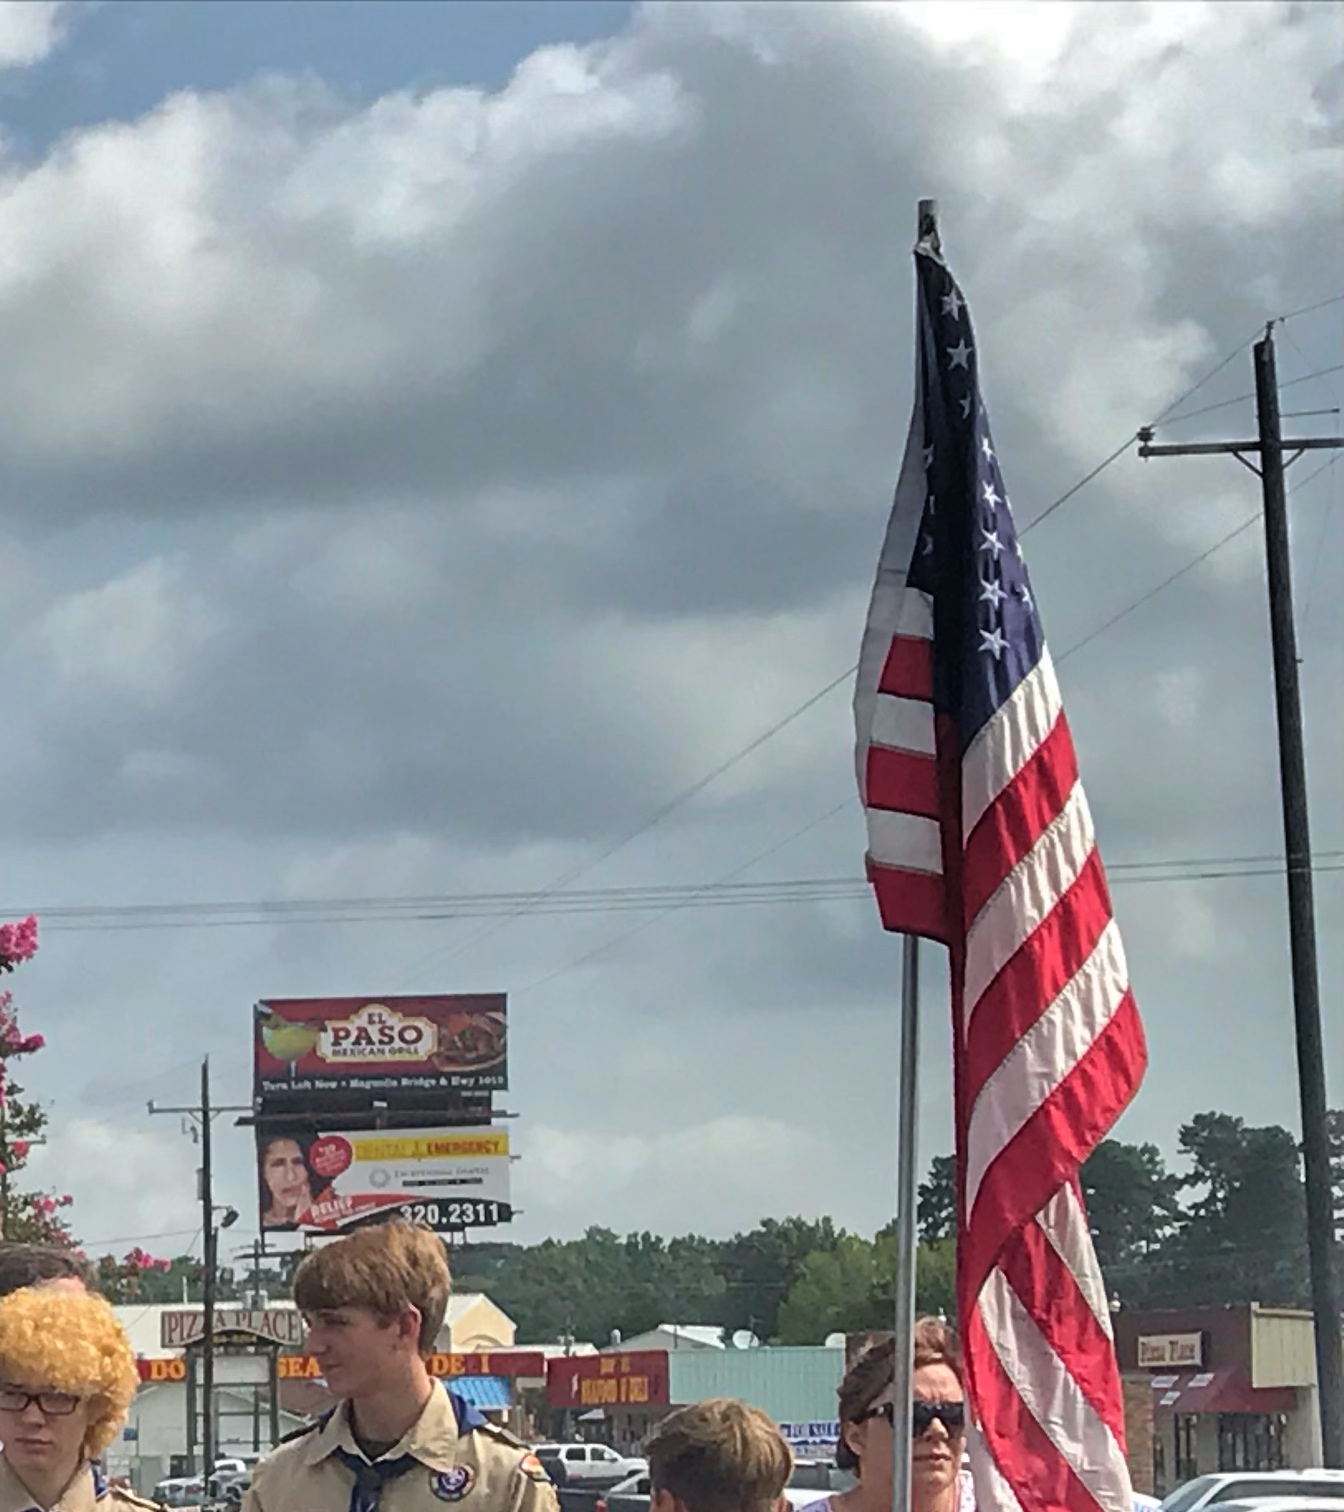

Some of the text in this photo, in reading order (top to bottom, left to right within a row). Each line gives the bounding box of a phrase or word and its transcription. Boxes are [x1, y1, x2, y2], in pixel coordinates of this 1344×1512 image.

[367, 1012, 387, 1025] EL
[330, 1024, 424, 1047] PASO
[331, 1046, 386, 1057] MEXICAN
[427, 1139, 499, 1156] EMERGENCY
[167, 1311, 298, 1344] PIZA PLACE
